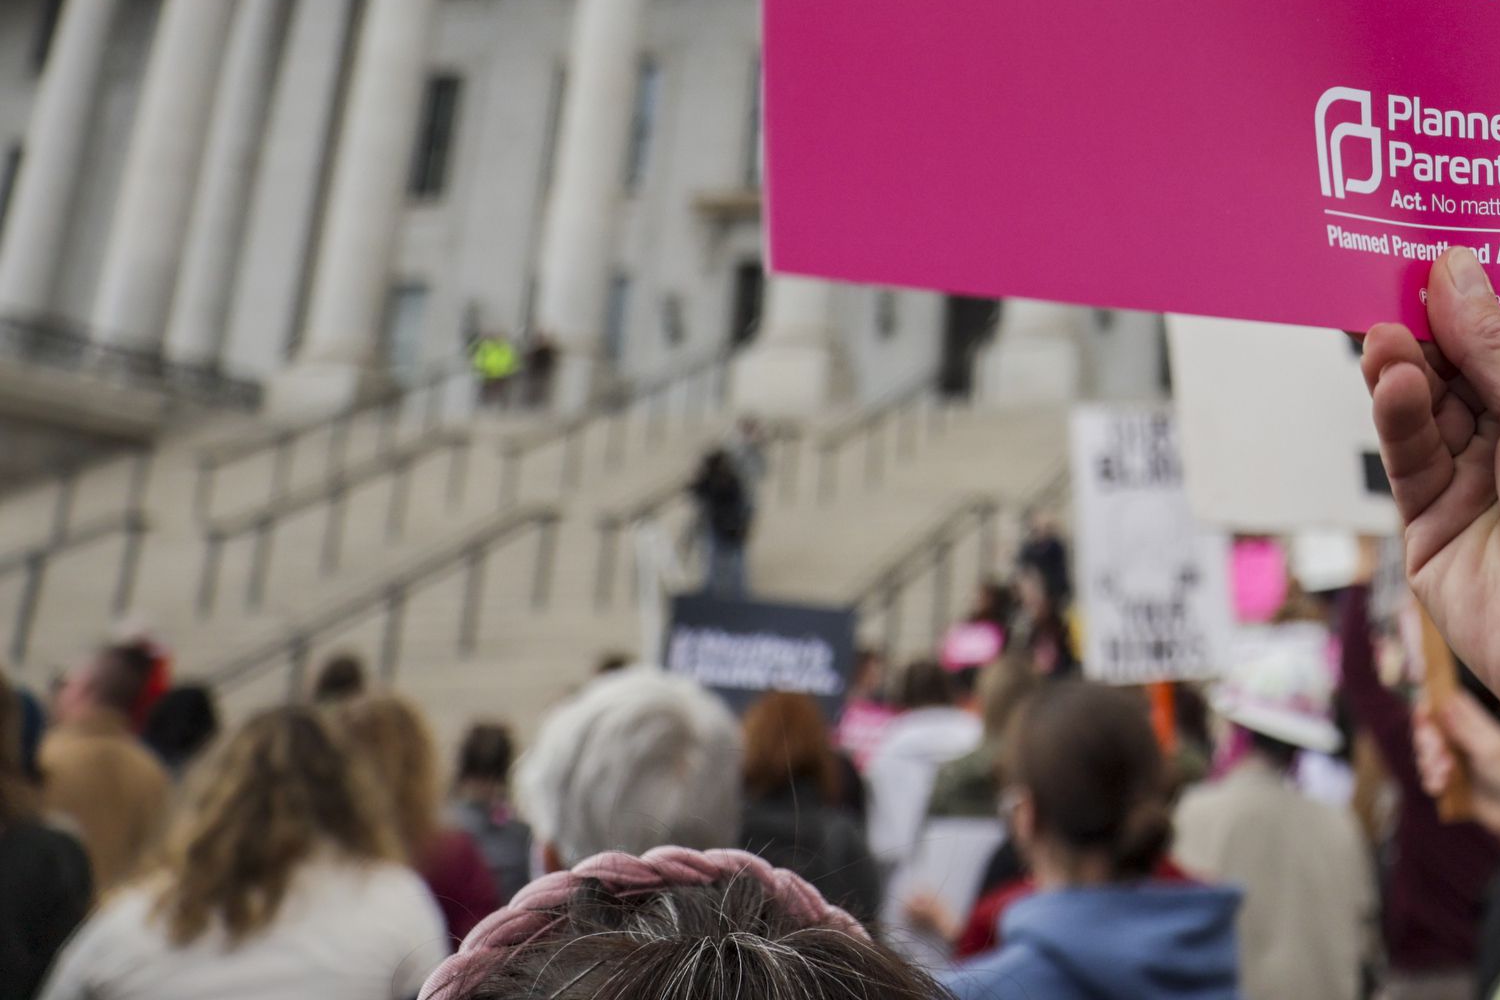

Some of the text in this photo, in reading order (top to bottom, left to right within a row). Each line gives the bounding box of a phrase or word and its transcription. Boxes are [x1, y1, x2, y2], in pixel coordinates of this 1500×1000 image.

[1390, 189, 1427, 212] Act.
[1431, 193, 1456, 214] No
[1326, 224, 1390, 255] Planned
[1391, 234, 1491, 265] Parentd
